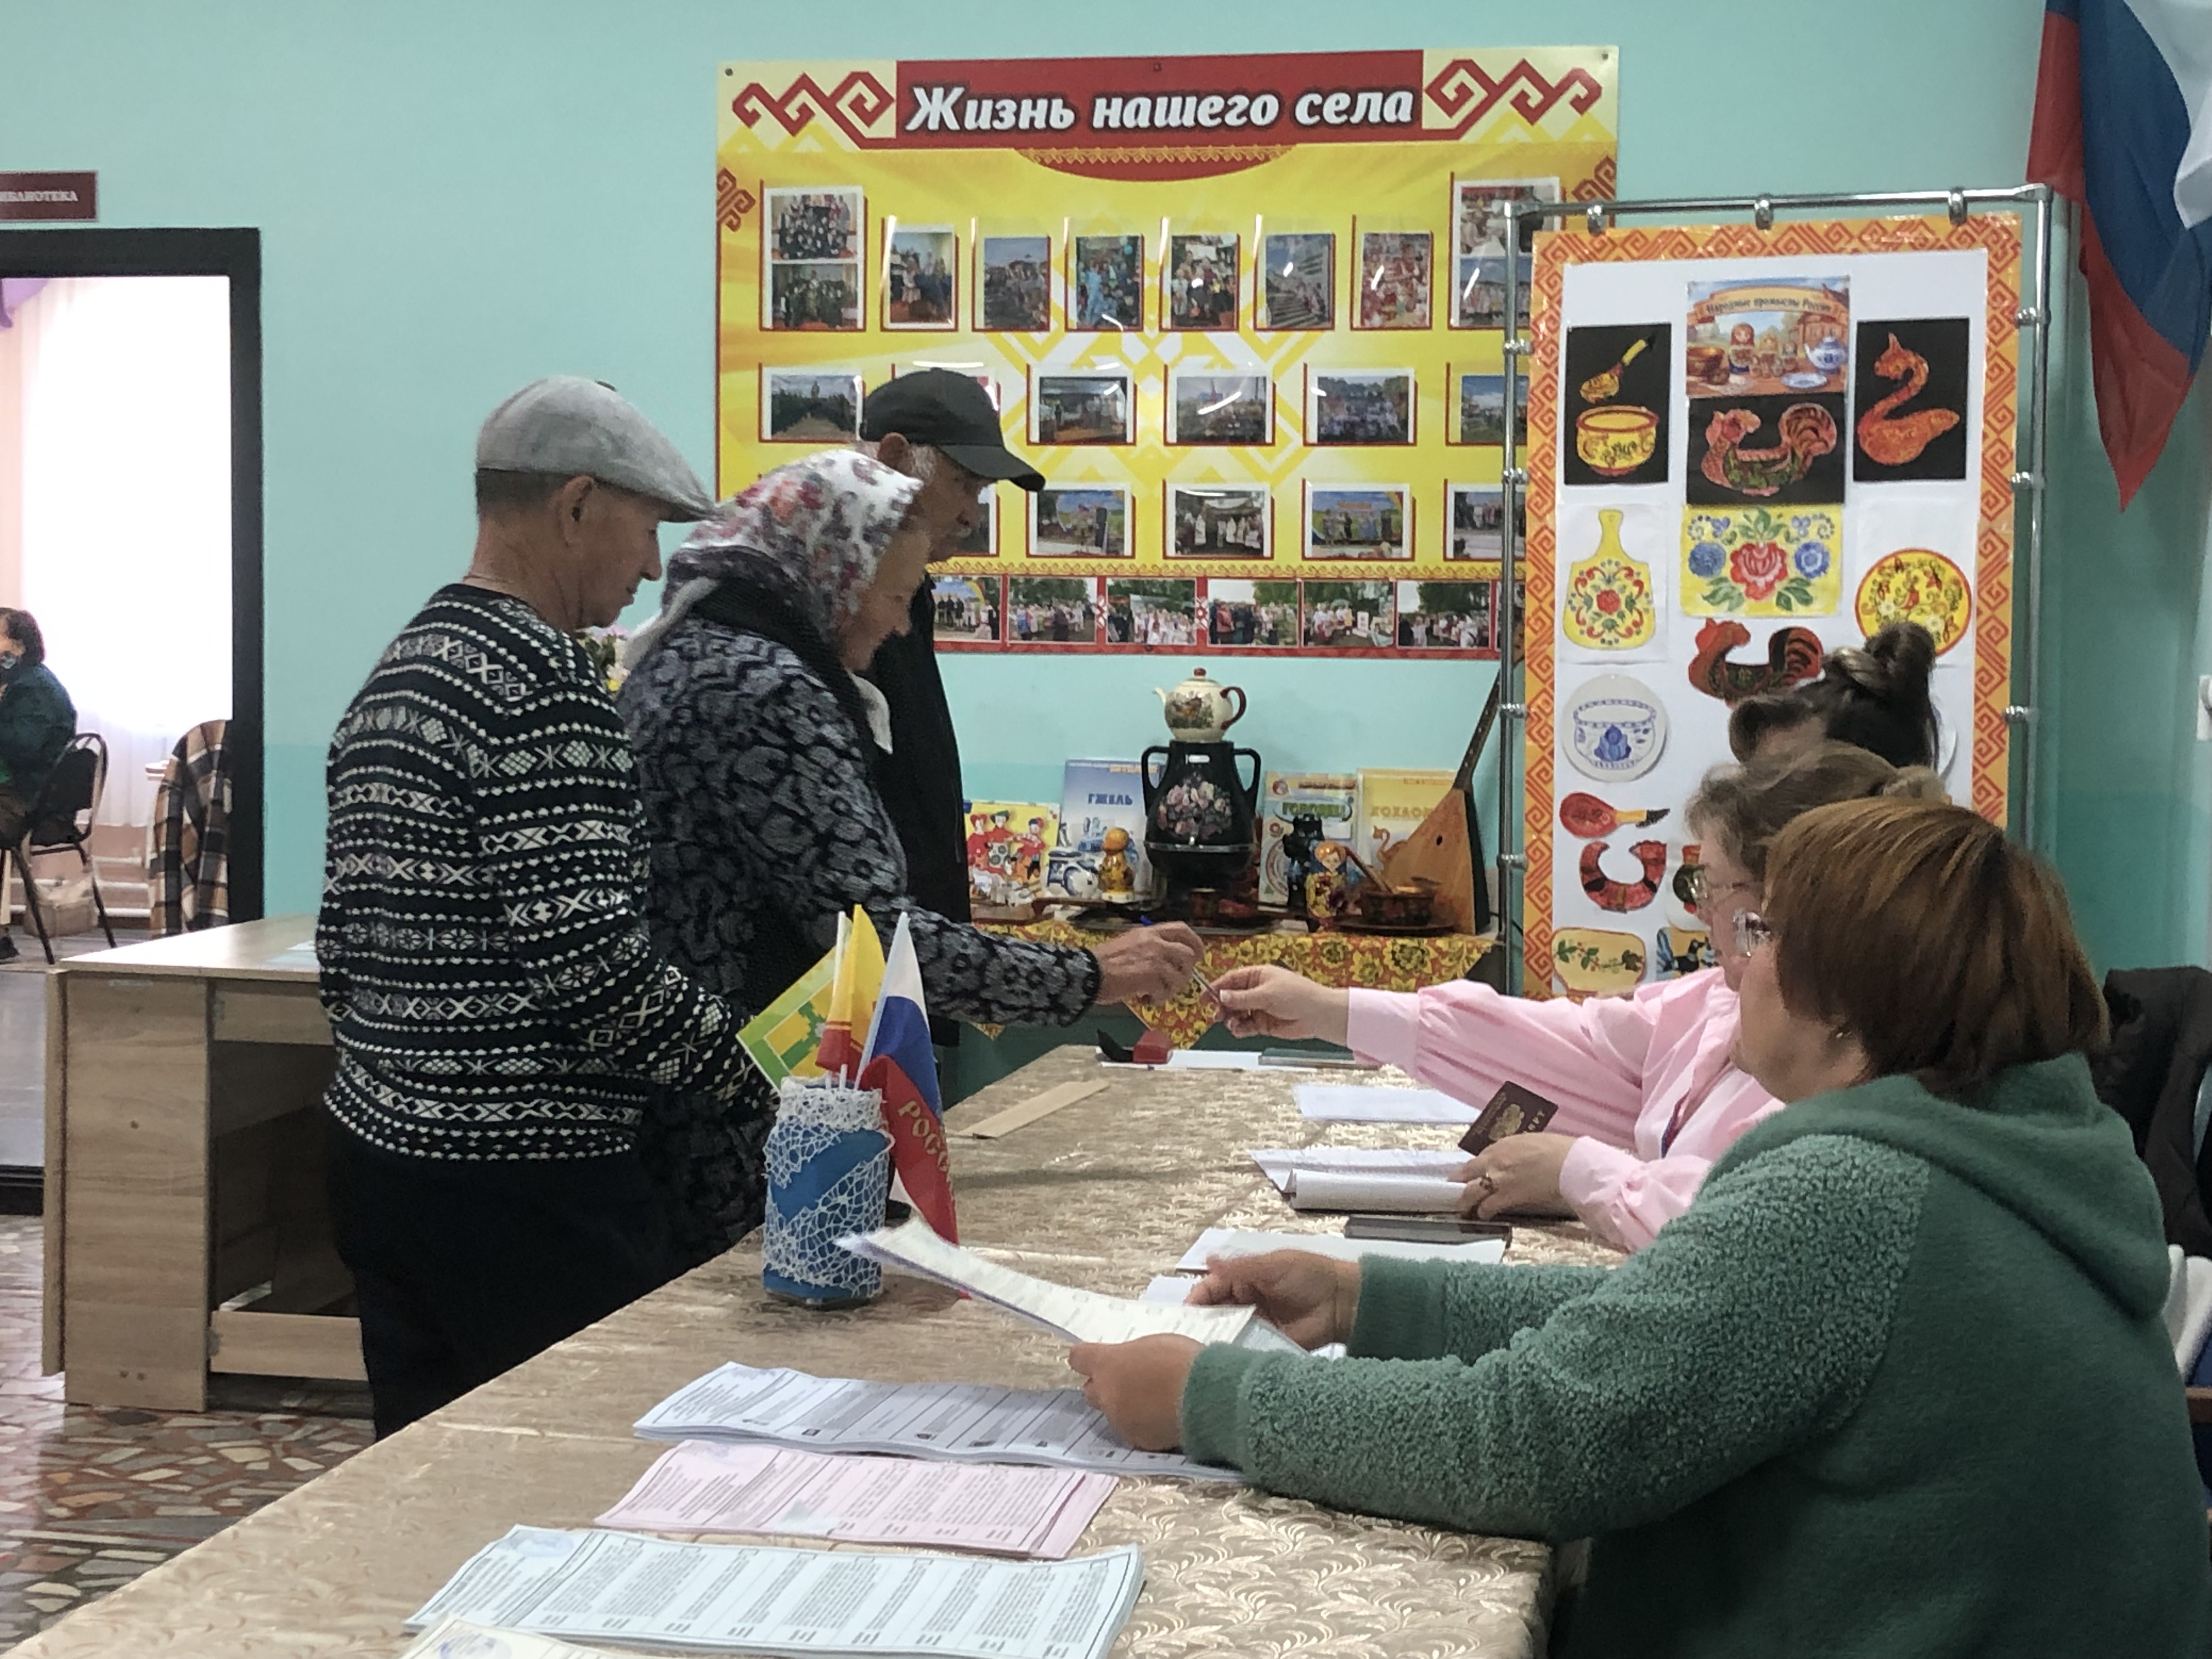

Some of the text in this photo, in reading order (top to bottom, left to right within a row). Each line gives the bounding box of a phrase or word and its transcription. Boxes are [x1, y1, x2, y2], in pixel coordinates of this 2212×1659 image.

[905, 86, 1414, 131] Жизнь нашего села
[1087, 793, 1133, 805] ГЖЕЛЬ
[898, 1101, 950, 1172] РОСС
